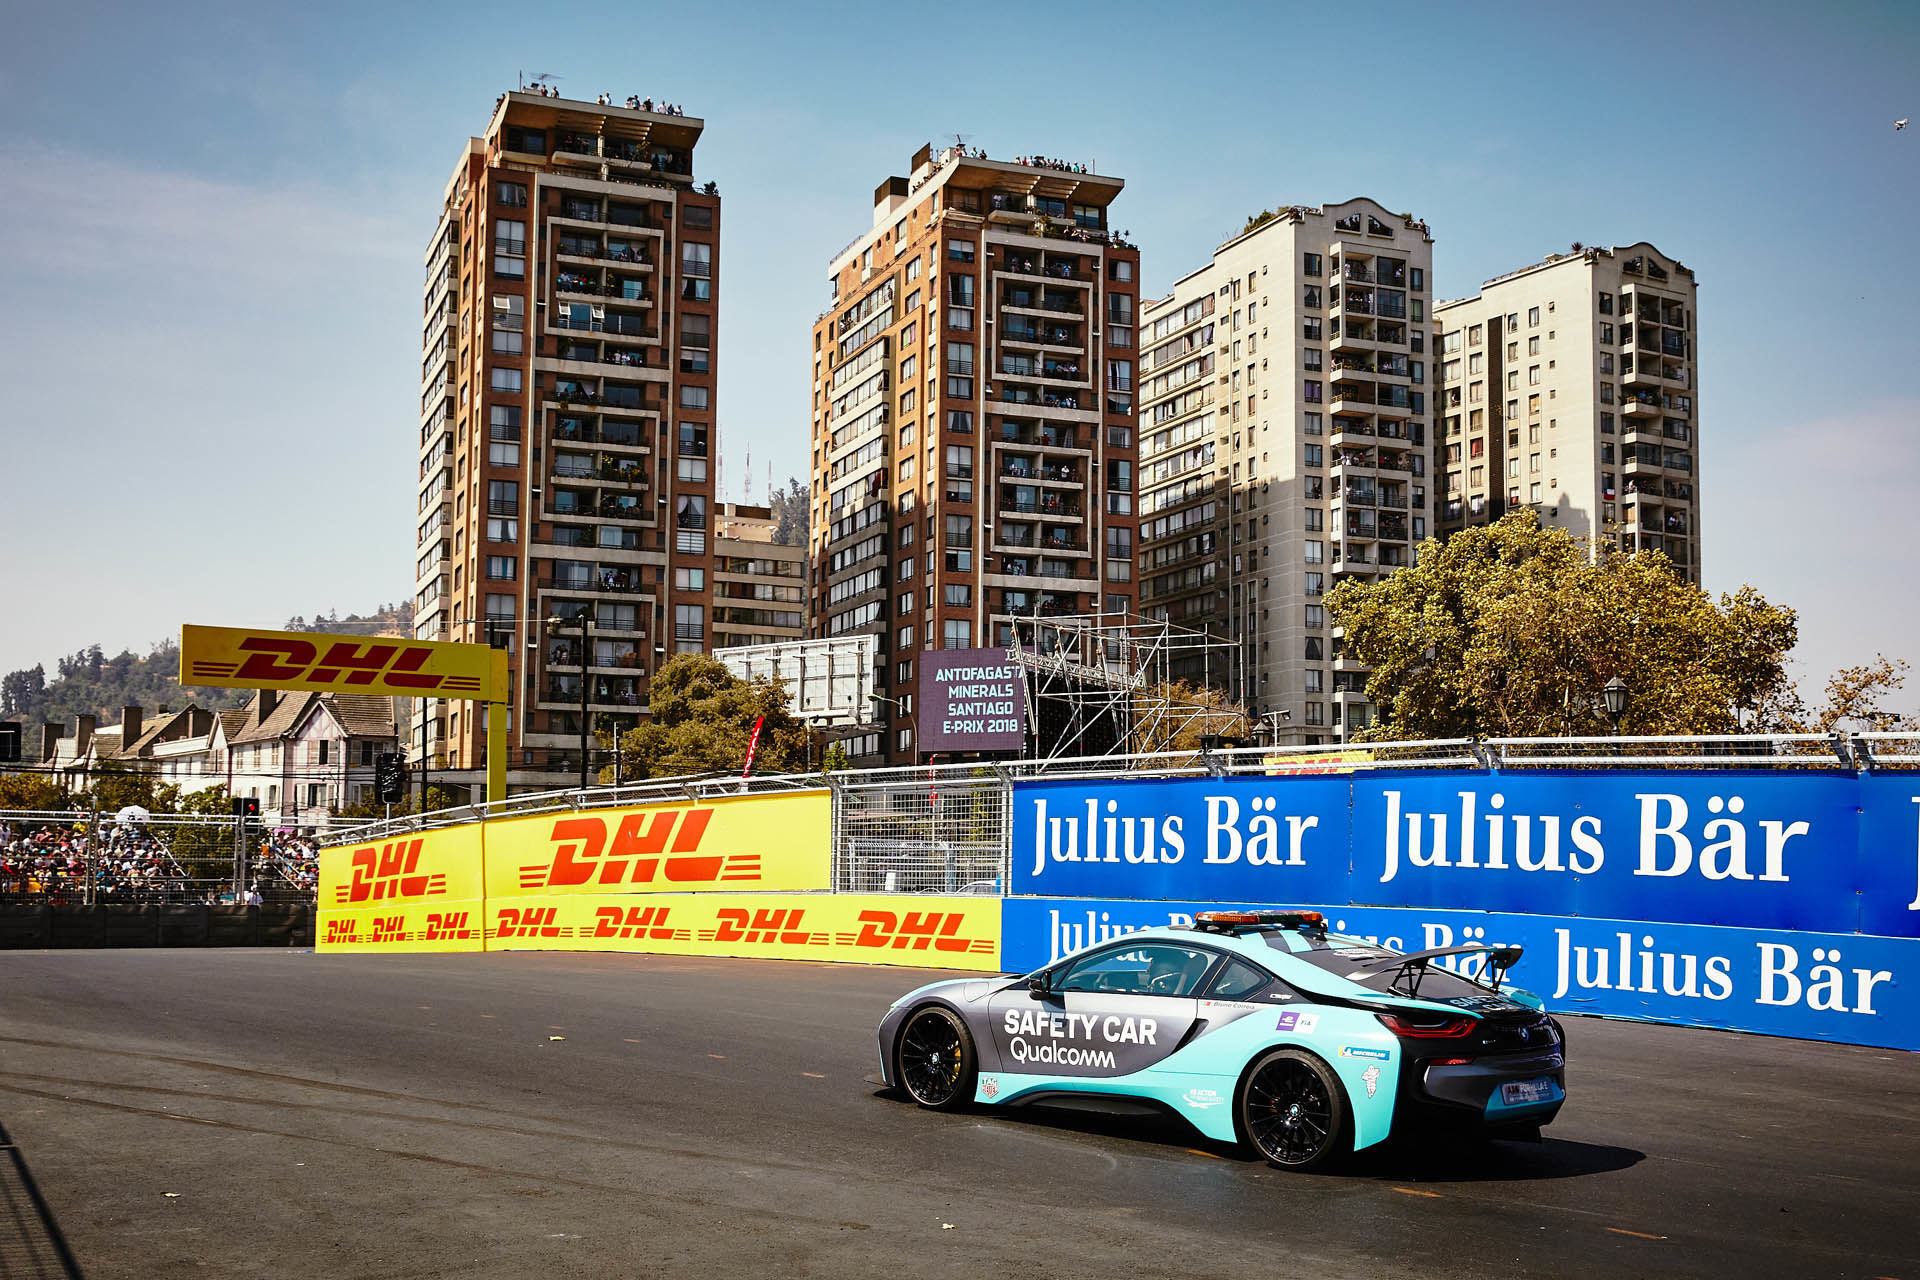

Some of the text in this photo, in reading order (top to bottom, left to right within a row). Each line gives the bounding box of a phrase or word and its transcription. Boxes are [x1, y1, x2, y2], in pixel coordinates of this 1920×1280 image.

[233, 636, 446, 689] DHL
[948, 684, 1014, 699] MINERALS
[948, 701, 1014, 716] SANTIAGO
[943, 719, 1018, 734] E-PRIX 2018
[548, 808, 723, 886] DHL
[1031, 796, 1319, 877] Julius Bär
[1379, 790, 1605, 883] Julius
[1633, 793, 1811, 882] Bär
[350, 838, 430, 902] DHL
[327, 919, 357, 944] DHL
[372, 915, 407, 942] DHL
[426, 912, 471, 941] DHL
[496, 907, 561, 938] DHL
[594, 906, 675, 940] DHL
[715, 908, 810, 945] DHL
[856, 910, 972, 953] DHL
[1553, 928, 1893, 1015] Julius Bär
[1004, 1009, 1157, 1046] SAFETY CAR
[1010, 1036, 1116, 1069] Qualcomm
